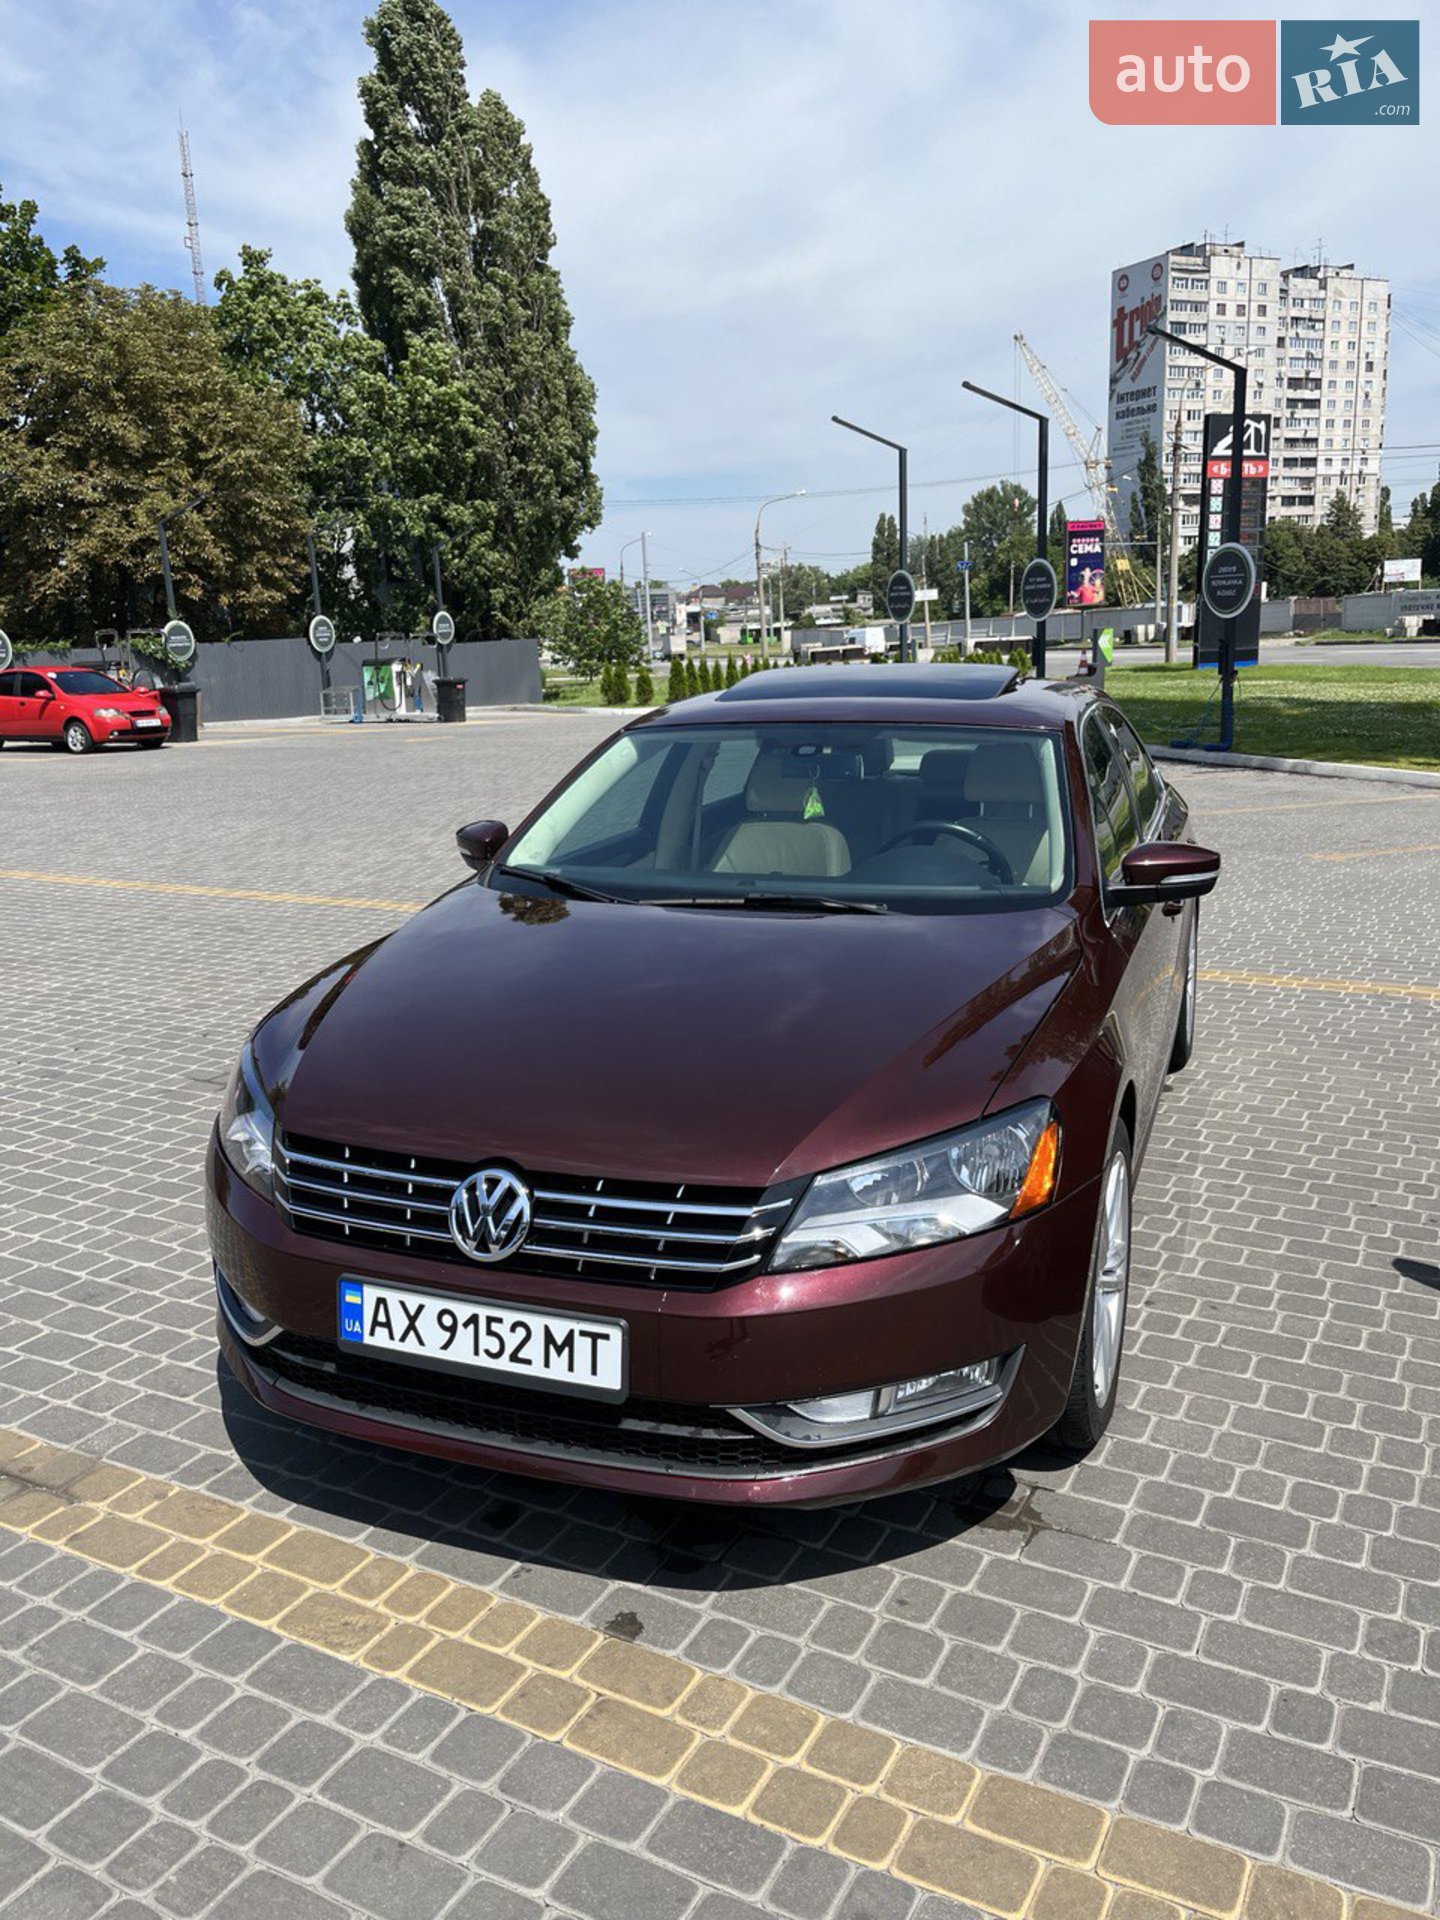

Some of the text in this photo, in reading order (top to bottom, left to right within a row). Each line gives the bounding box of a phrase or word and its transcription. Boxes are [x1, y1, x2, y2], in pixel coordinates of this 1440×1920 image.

[344, 1318, 362, 1334] UA
[368, 1296, 611, 1377] AX 9152 MT
